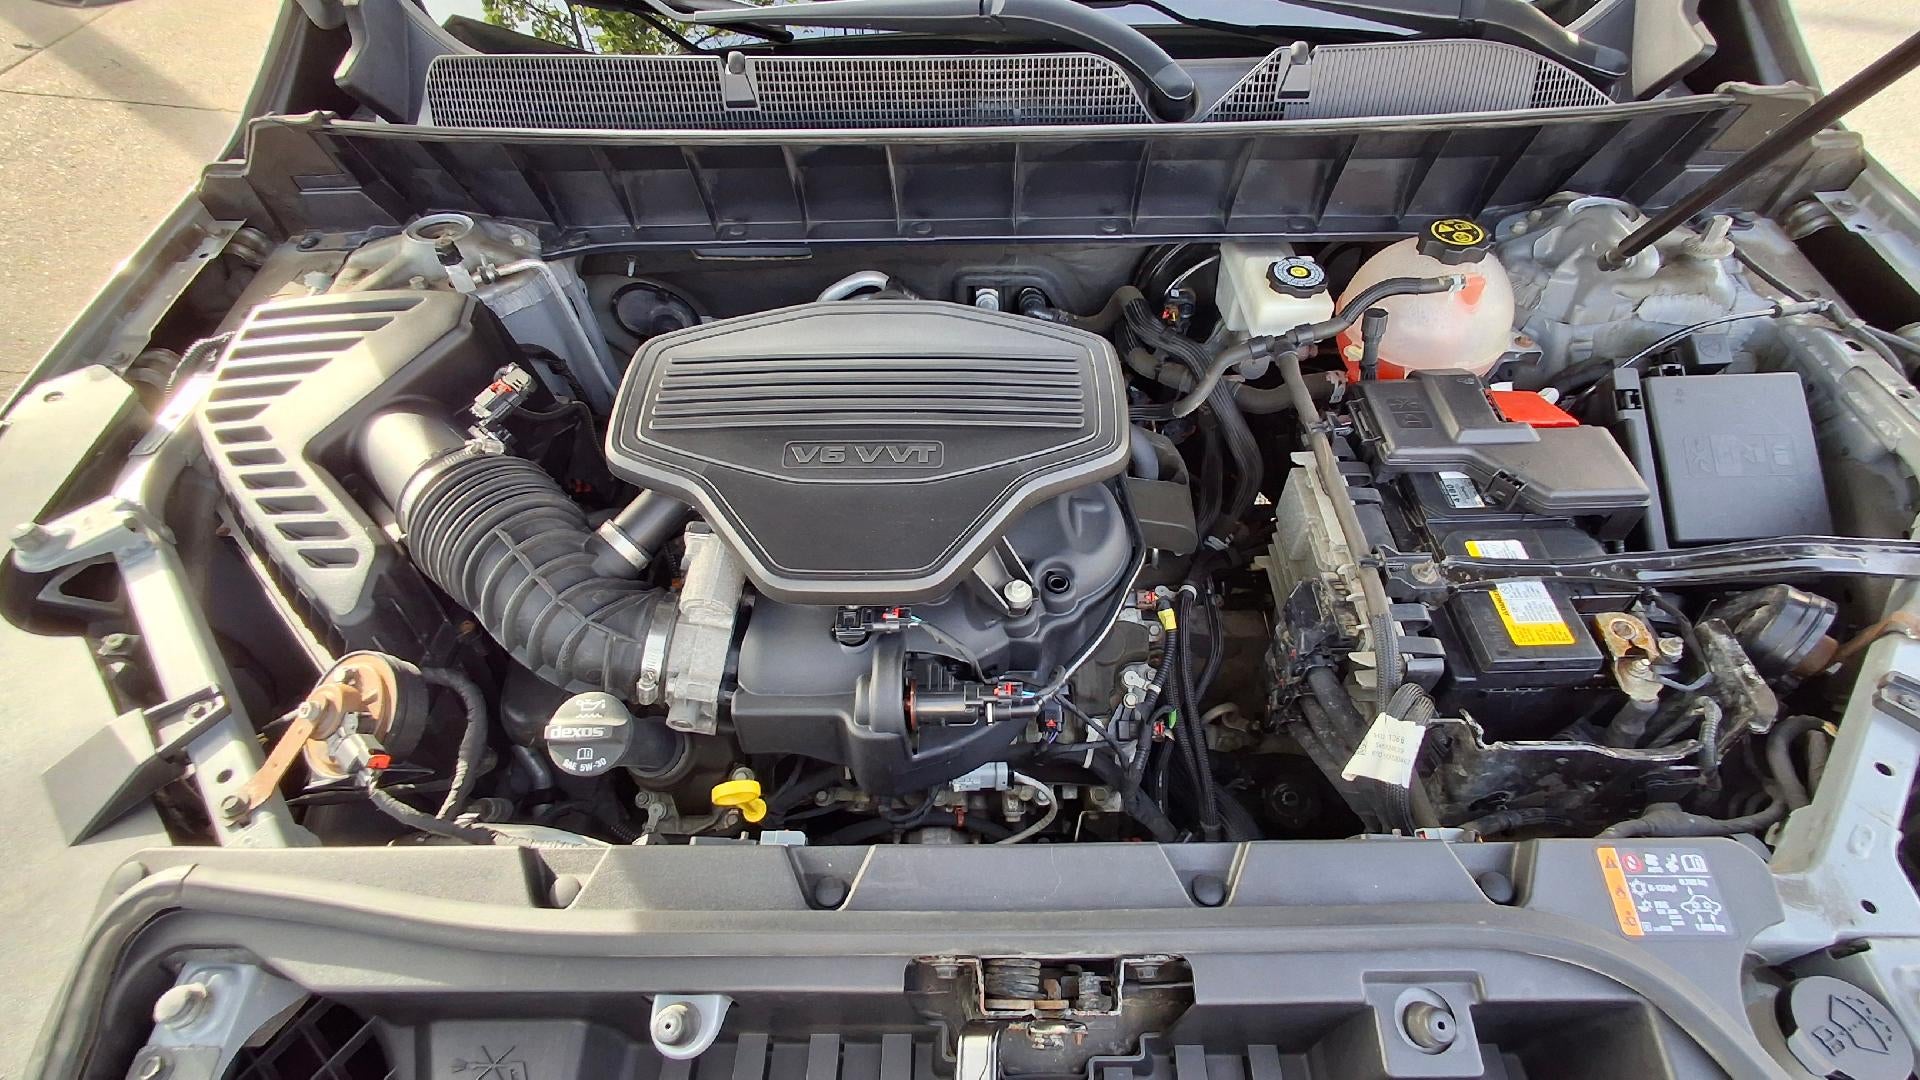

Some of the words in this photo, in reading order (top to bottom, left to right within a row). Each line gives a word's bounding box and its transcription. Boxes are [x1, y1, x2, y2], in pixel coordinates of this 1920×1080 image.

[791, 445, 846, 463] V6
[855, 445, 937, 463] VVT
[550, 725, 605, 738] dexos
[562, 759, 577, 771] SAE
[579, 757, 607, 772] 5W-30
